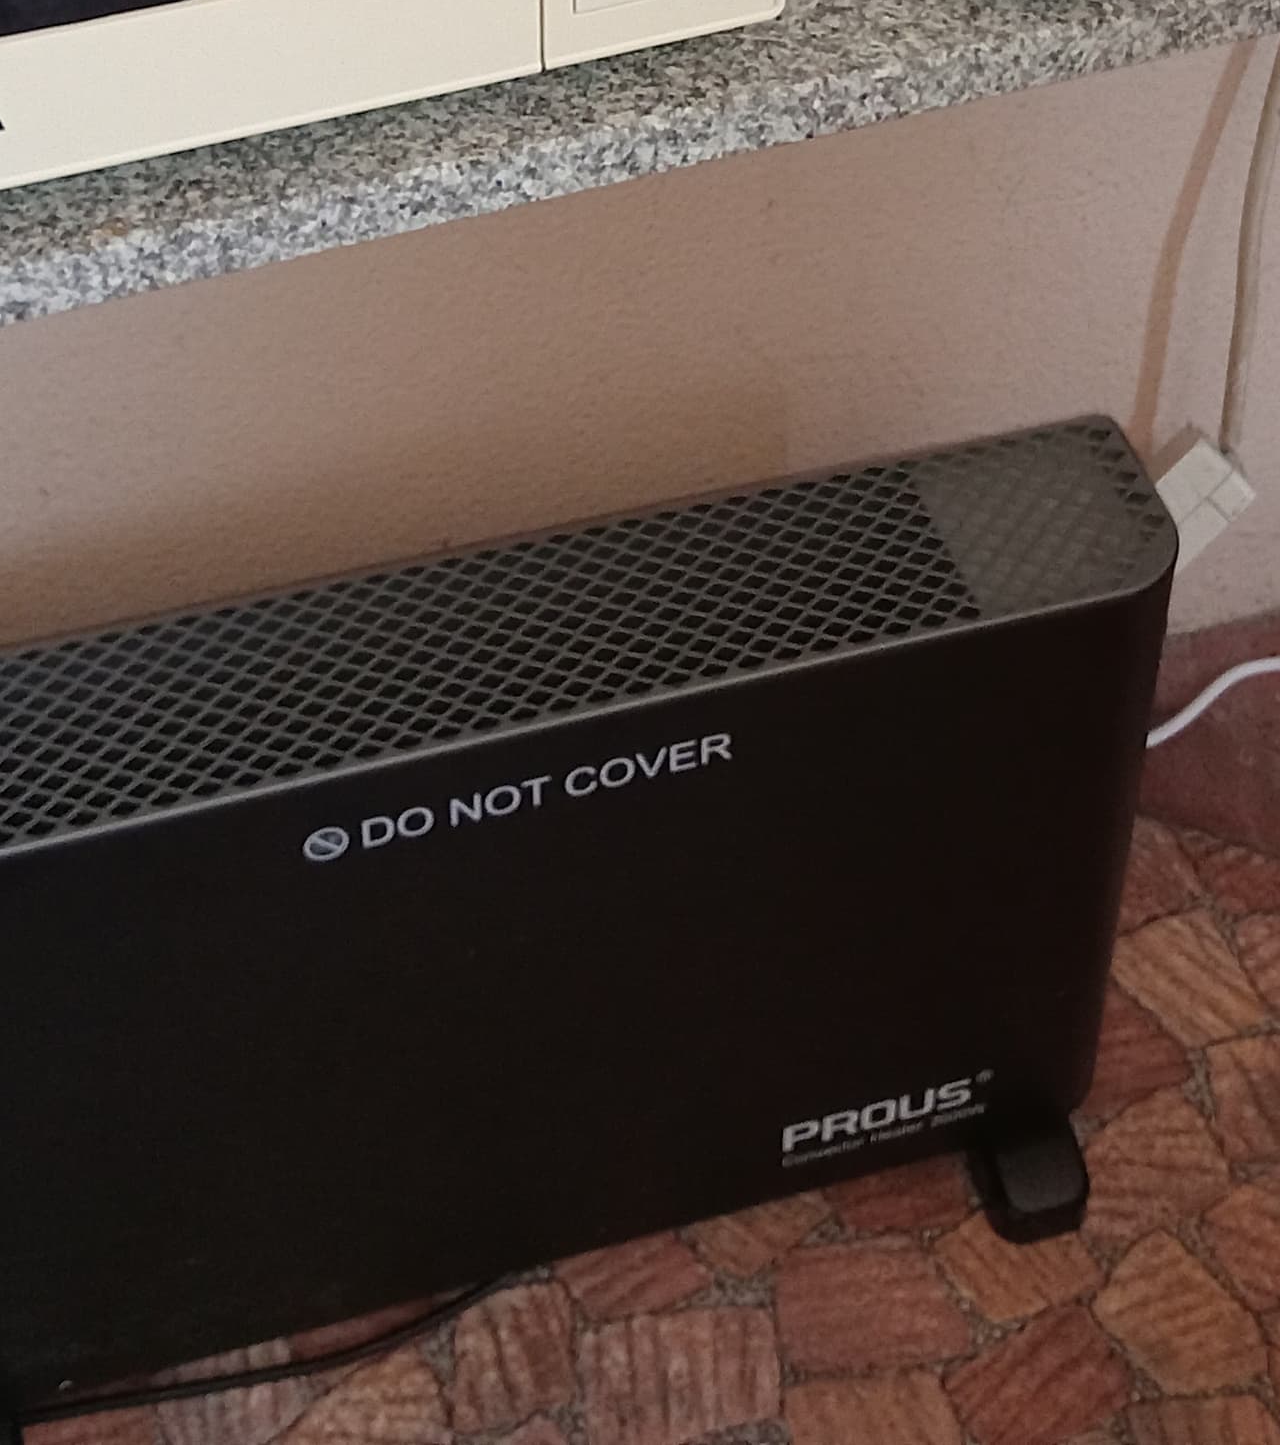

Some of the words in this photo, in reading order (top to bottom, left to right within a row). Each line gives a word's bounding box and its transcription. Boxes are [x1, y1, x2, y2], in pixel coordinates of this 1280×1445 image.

[360, 805, 434, 849] DO
[450, 776, 552, 827] NOT
[564, 732, 733, 797] COVER
[781, 1077, 973, 1152] PROUS
